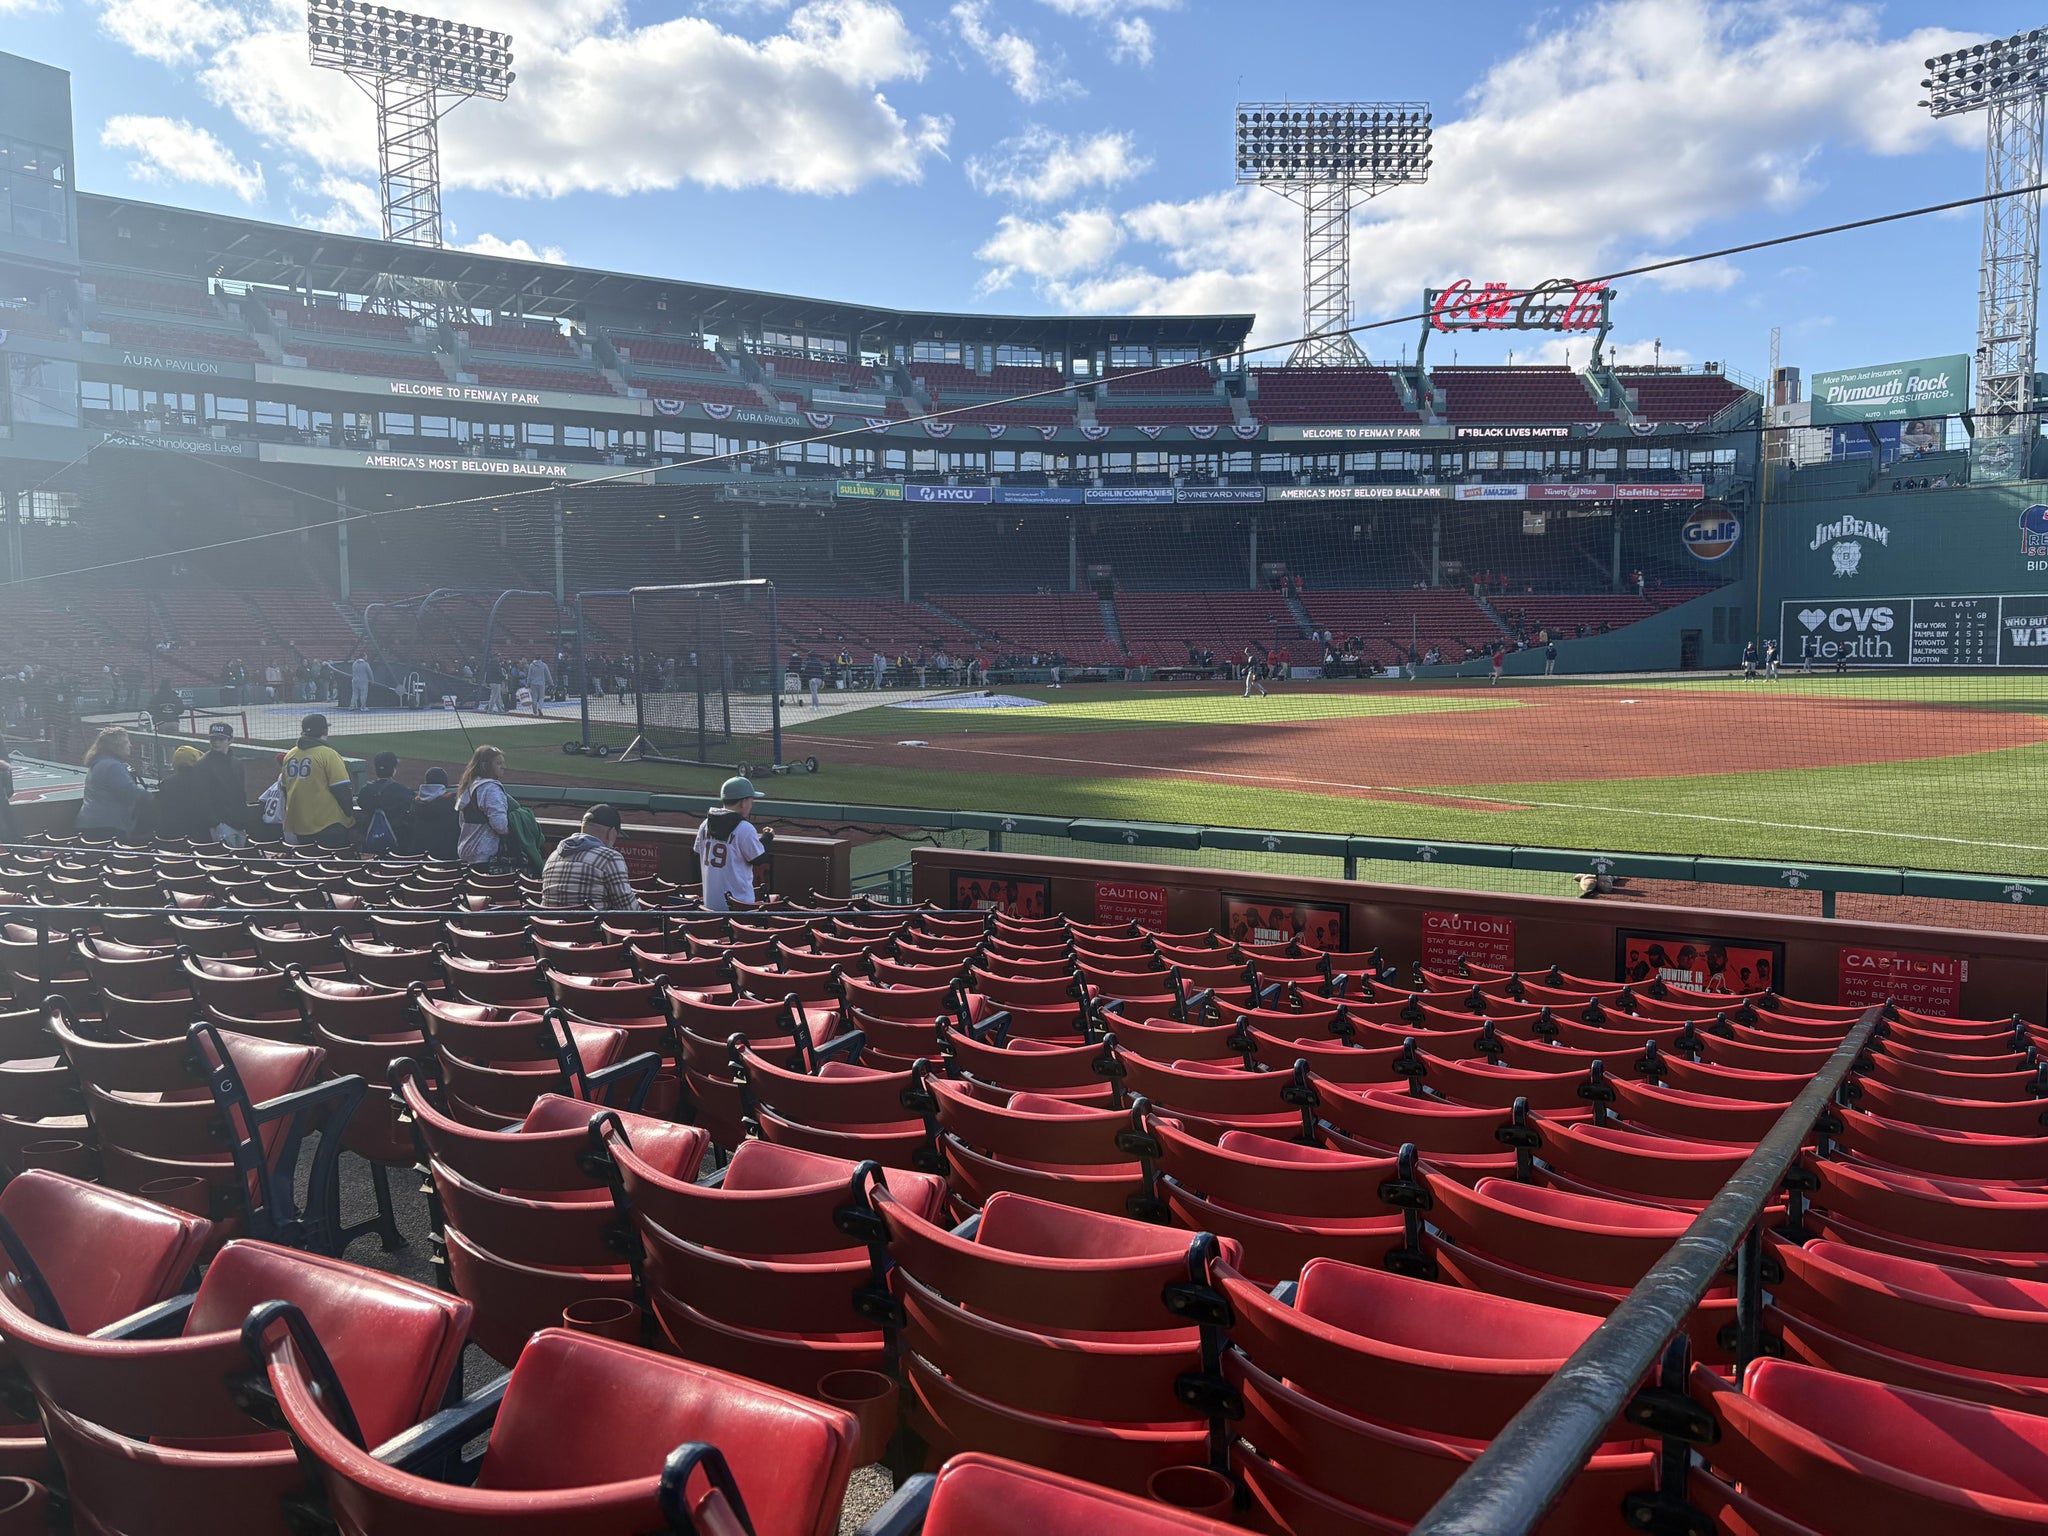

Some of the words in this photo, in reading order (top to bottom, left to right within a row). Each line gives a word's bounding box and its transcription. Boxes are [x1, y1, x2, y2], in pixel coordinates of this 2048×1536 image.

[166, 359, 218, 374] PAVILION
[1823, 377, 1840, 385] More
[1841, 374, 1856, 382] Than
[1857, 372, 1870, 380] Just
[391, 382, 443, 397] WELCOME
[447, 387, 460, 398] TO
[464, 388, 508, 402] FENWAY
[512, 393, 540, 404] PARK
[1827, 379, 1902, 403] Plymouth
[1905, 373, 1950, 393] Rock
[764, 414, 800, 426] PAVILION
[1302, 429, 1343, 438] WELCOME
[1346, 429, 1357, 437] TO
[1359, 429, 1395, 437] FENWAY
[1398, 428, 1421, 437] PARK
[1473, 428, 1503, 437] BLACK
[1505, 428, 1531, 437] LIVES
[1532, 428, 1568, 437] MATTER
[140, 436, 211, 453] Technologies
[214, 441, 241, 454] Level
[365, 456, 425, 469] AMERICA'S
[429, 460, 458, 470] MOST
[462, 461, 509, 473] BELOVED
[513, 465, 566, 476] BALLPARK
[840, 485, 875, 496] SULLIVAN
[885, 488, 900, 497] TIRE
[938, 490, 973, 499] HYCU
[1280, 489, 1326, 498] AMERICA'S
[1329, 489, 1350, 498] MOST
[1354, 488, 1393, 497] BELOVED
[1395, 488, 1441, 497] BALLPARK
[1619, 488, 1659, 497] Safelite
[1684, 521, 1736, 542] Gulf
[1951, 600, 1978, 608] EAST
[1829, 607, 1894, 632] CVS
[2005, 617, 2027, 627] WHO
[2029, 617, 2048, 627] BUT
[1800, 635, 1893, 658] Health
[286, 757, 312, 780] 66
[704, 841, 728, 869] 19
[1099, 887, 1163, 901] CAUTION!
[1115, 906, 1136, 914] CLEAR
[1428, 917, 1509, 935] CAUTION!
[1448, 939, 1475, 947] CLEAR
[1430, 966, 1444, 974] THE
[1658, 967, 1693, 983] SHOWTIME
[1695, 971, 1703, 984] IN
[1845, 977, 1868, 985] STAY
[1872, 980, 1908, 990] CLEAR
[1932, 986, 1953, 994] NET
[1847, 989, 1867, 997] AND
[1889, 994, 1920, 1003] ALERT
[1928, 997, 1951, 1005] FOR
[566, 1053, 572, 1064] F
[221, 1080, 232, 1092] G
